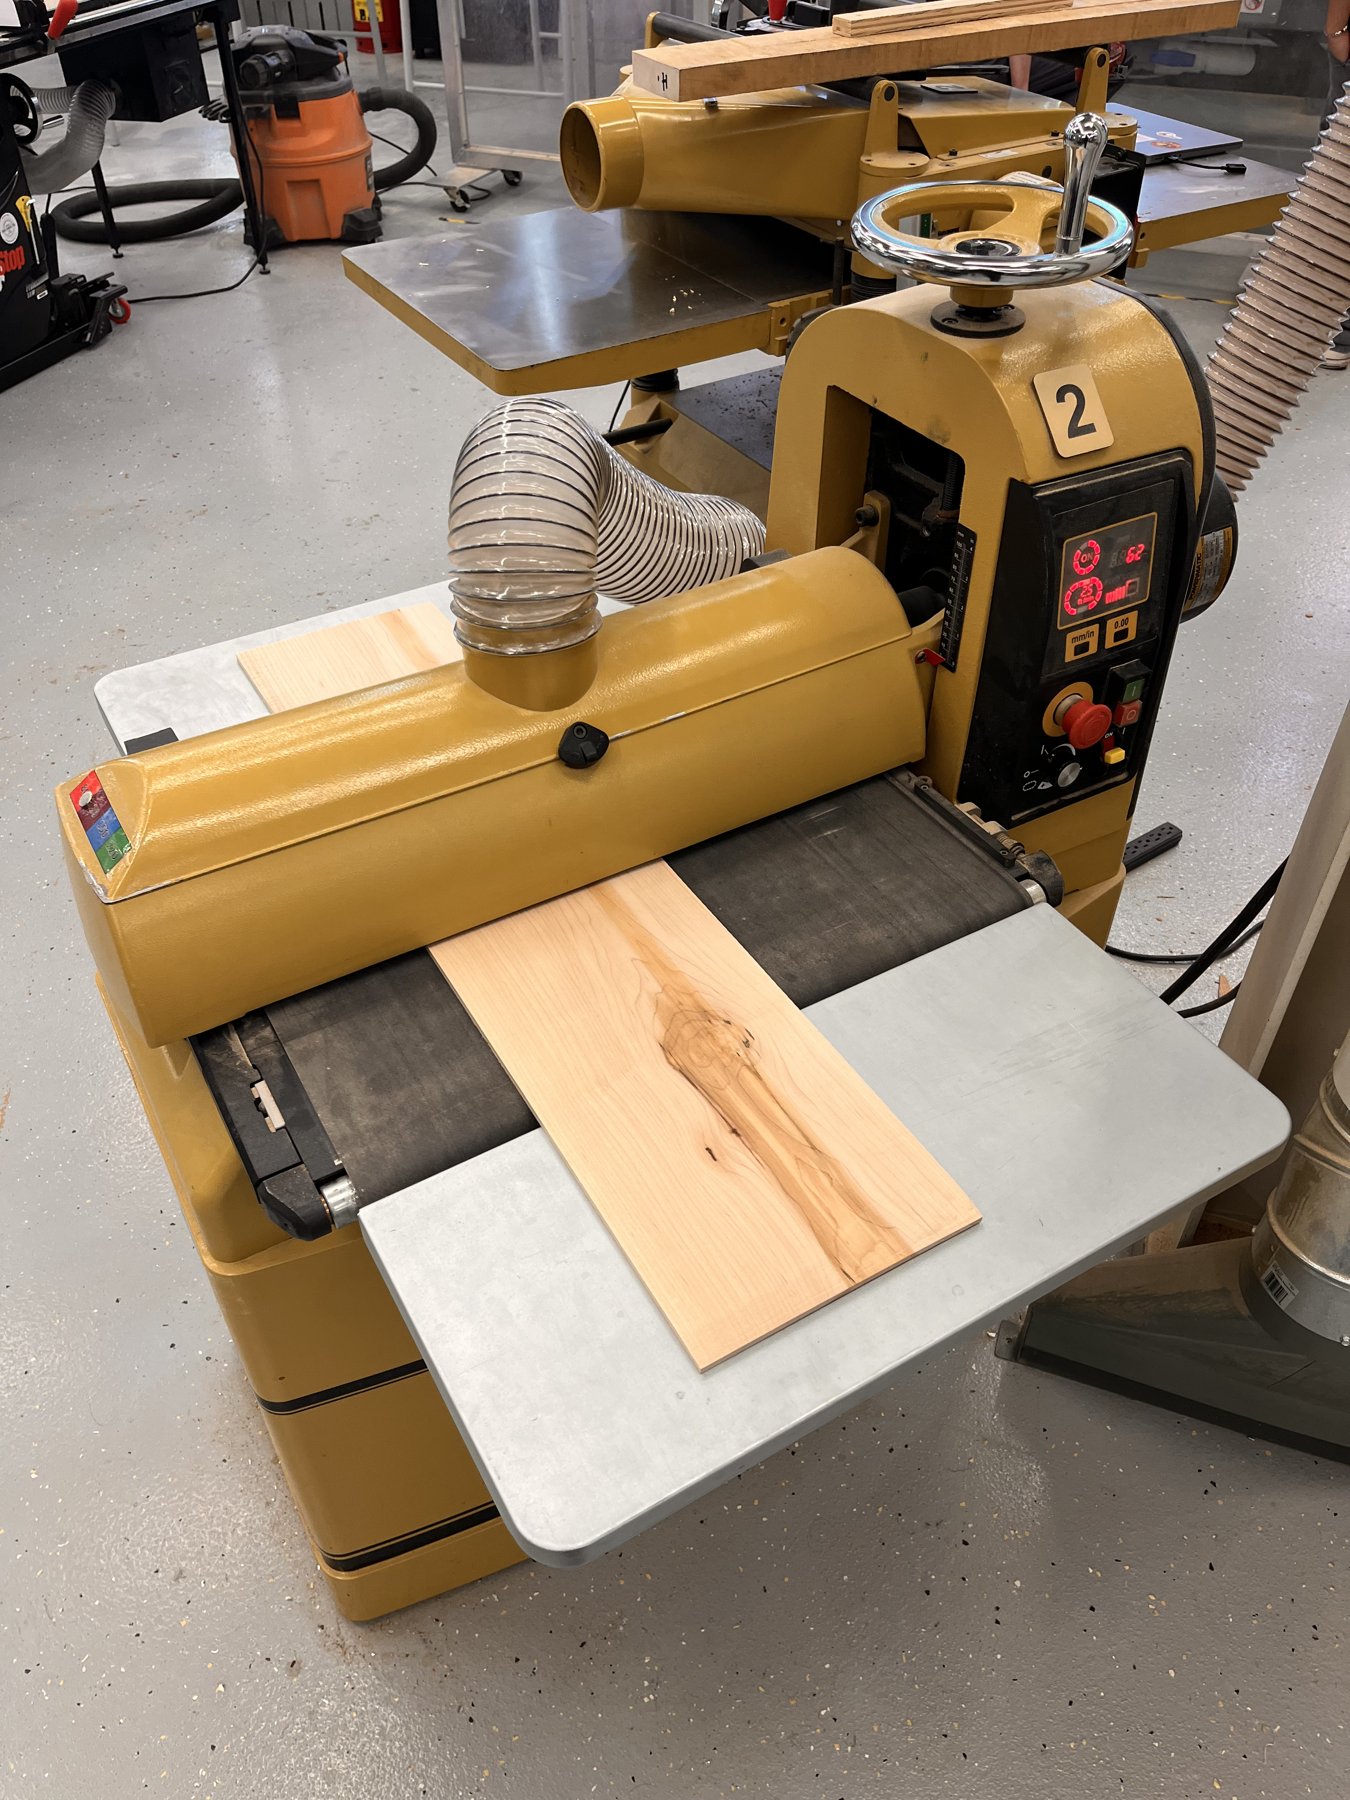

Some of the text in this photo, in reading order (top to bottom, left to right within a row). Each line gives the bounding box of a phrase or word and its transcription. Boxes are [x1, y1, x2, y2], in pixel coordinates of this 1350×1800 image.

[1055, 383, 1097, 439] 2
[1125, 543, 1145, 564] 62
[1114, 617, 1130, 630] 0.00
[1071, 630, 1095, 644] mm/in
